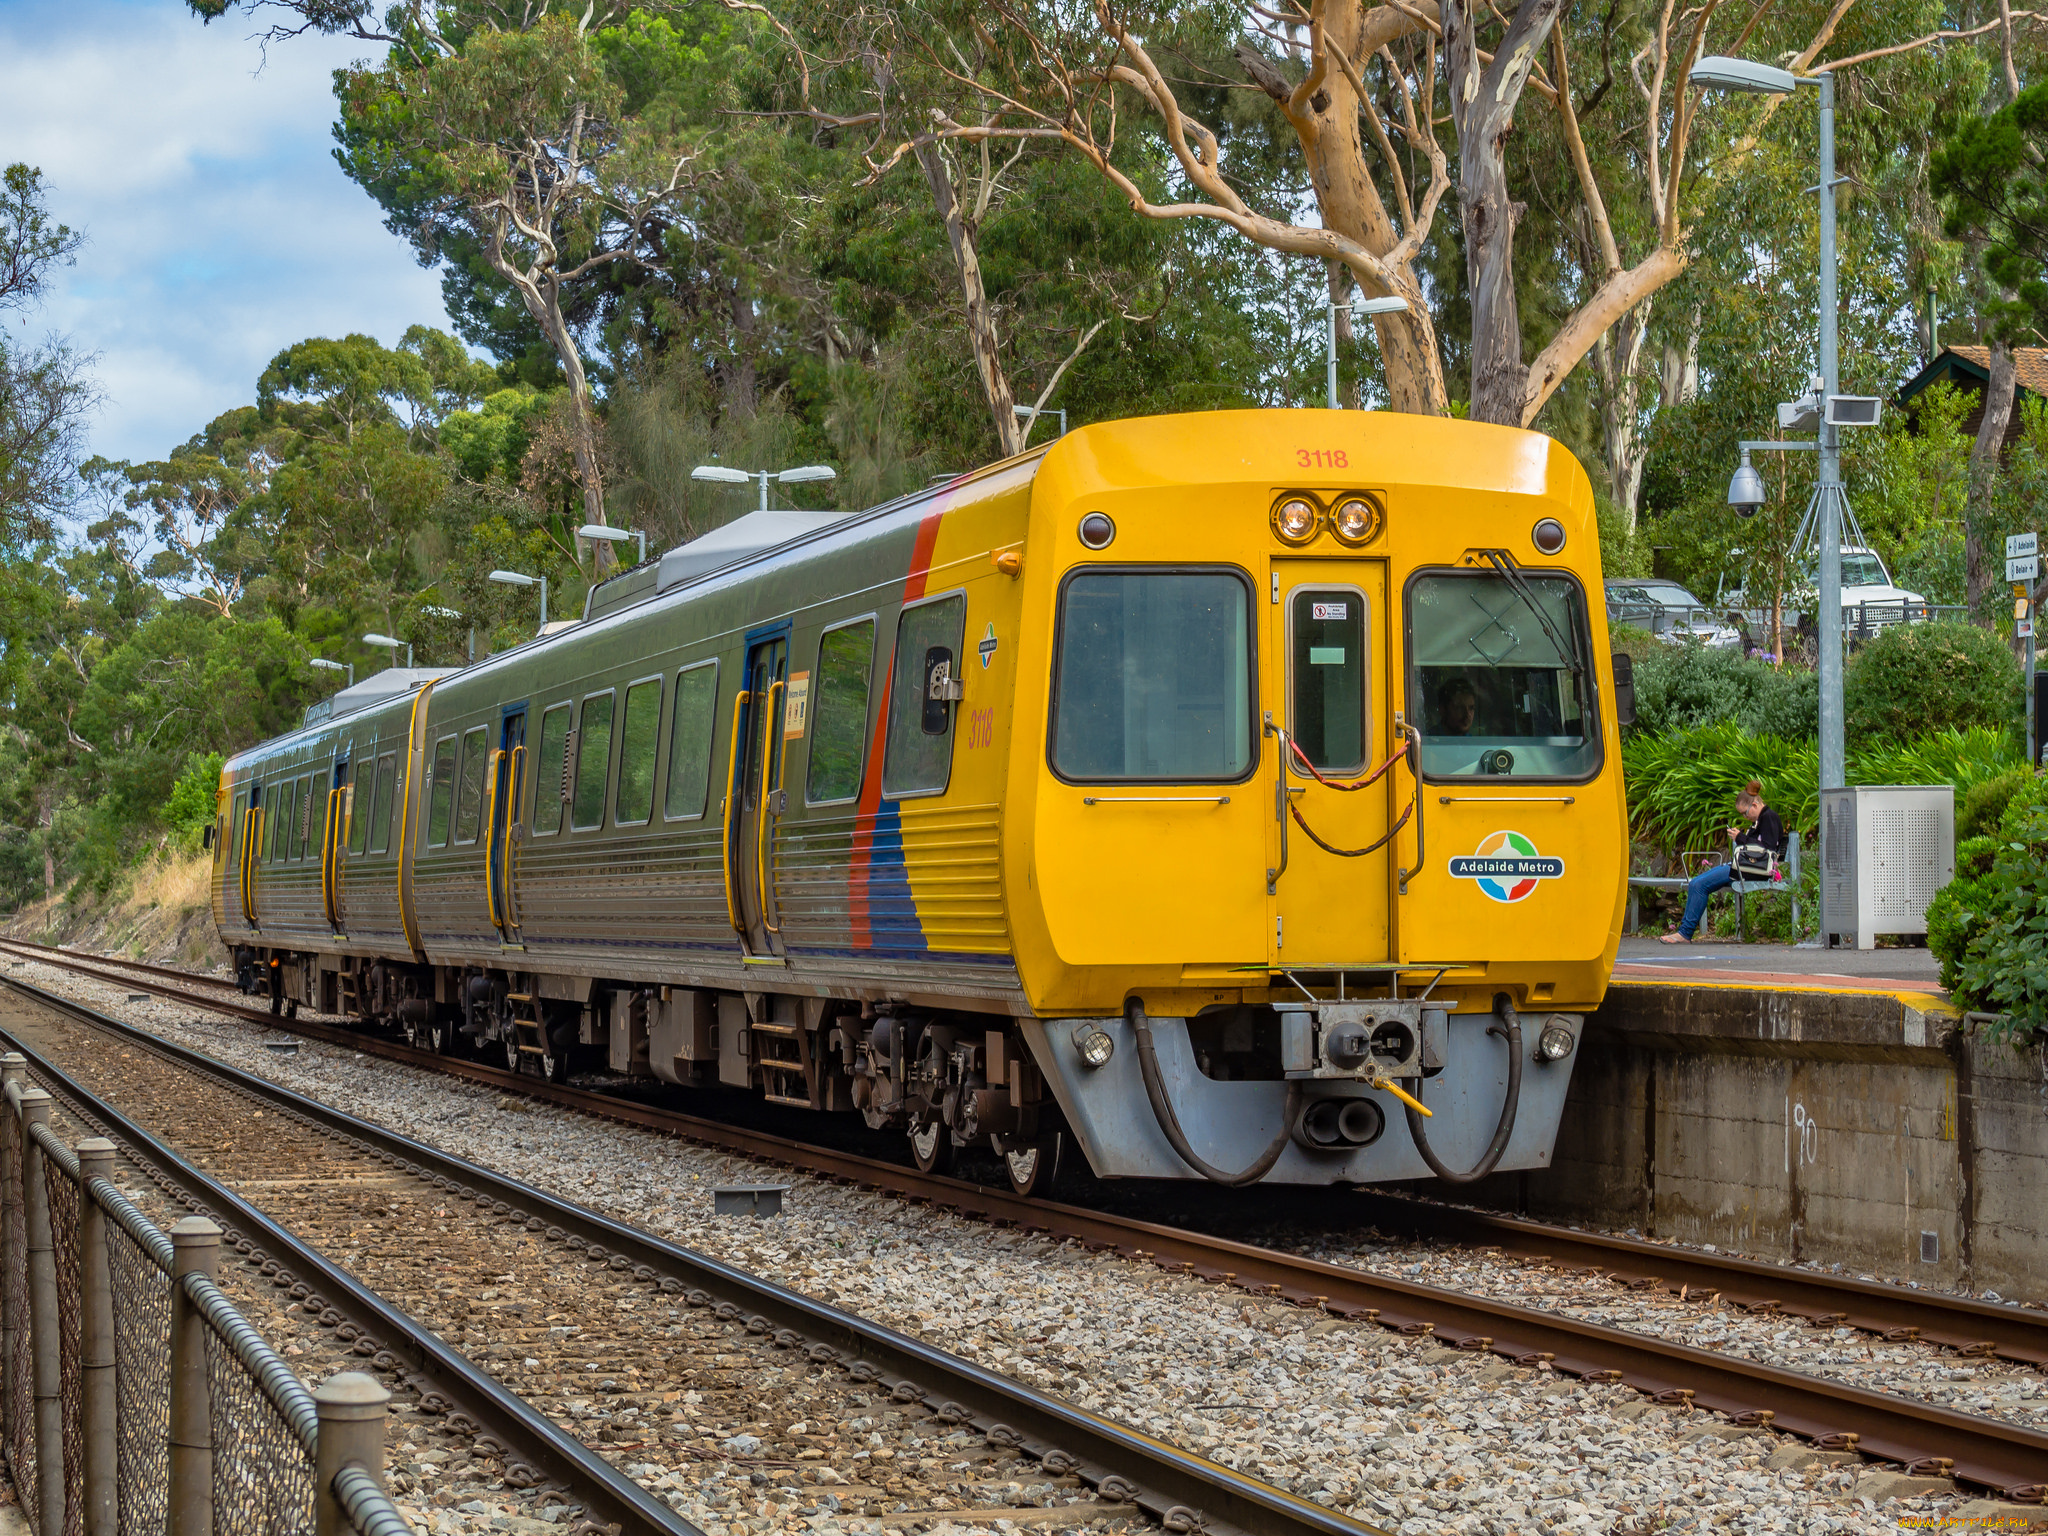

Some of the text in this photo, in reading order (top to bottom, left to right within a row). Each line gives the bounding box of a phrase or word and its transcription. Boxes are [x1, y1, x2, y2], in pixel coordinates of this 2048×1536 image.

[1296, 449, 1349, 468] 3118
[2018, 540, 2036, 550] Adelaide
[2015, 564, 2028, 574] Belair
[968, 706, 994, 750] 3118
[1459, 861, 1555, 873] Adelaide Metro
